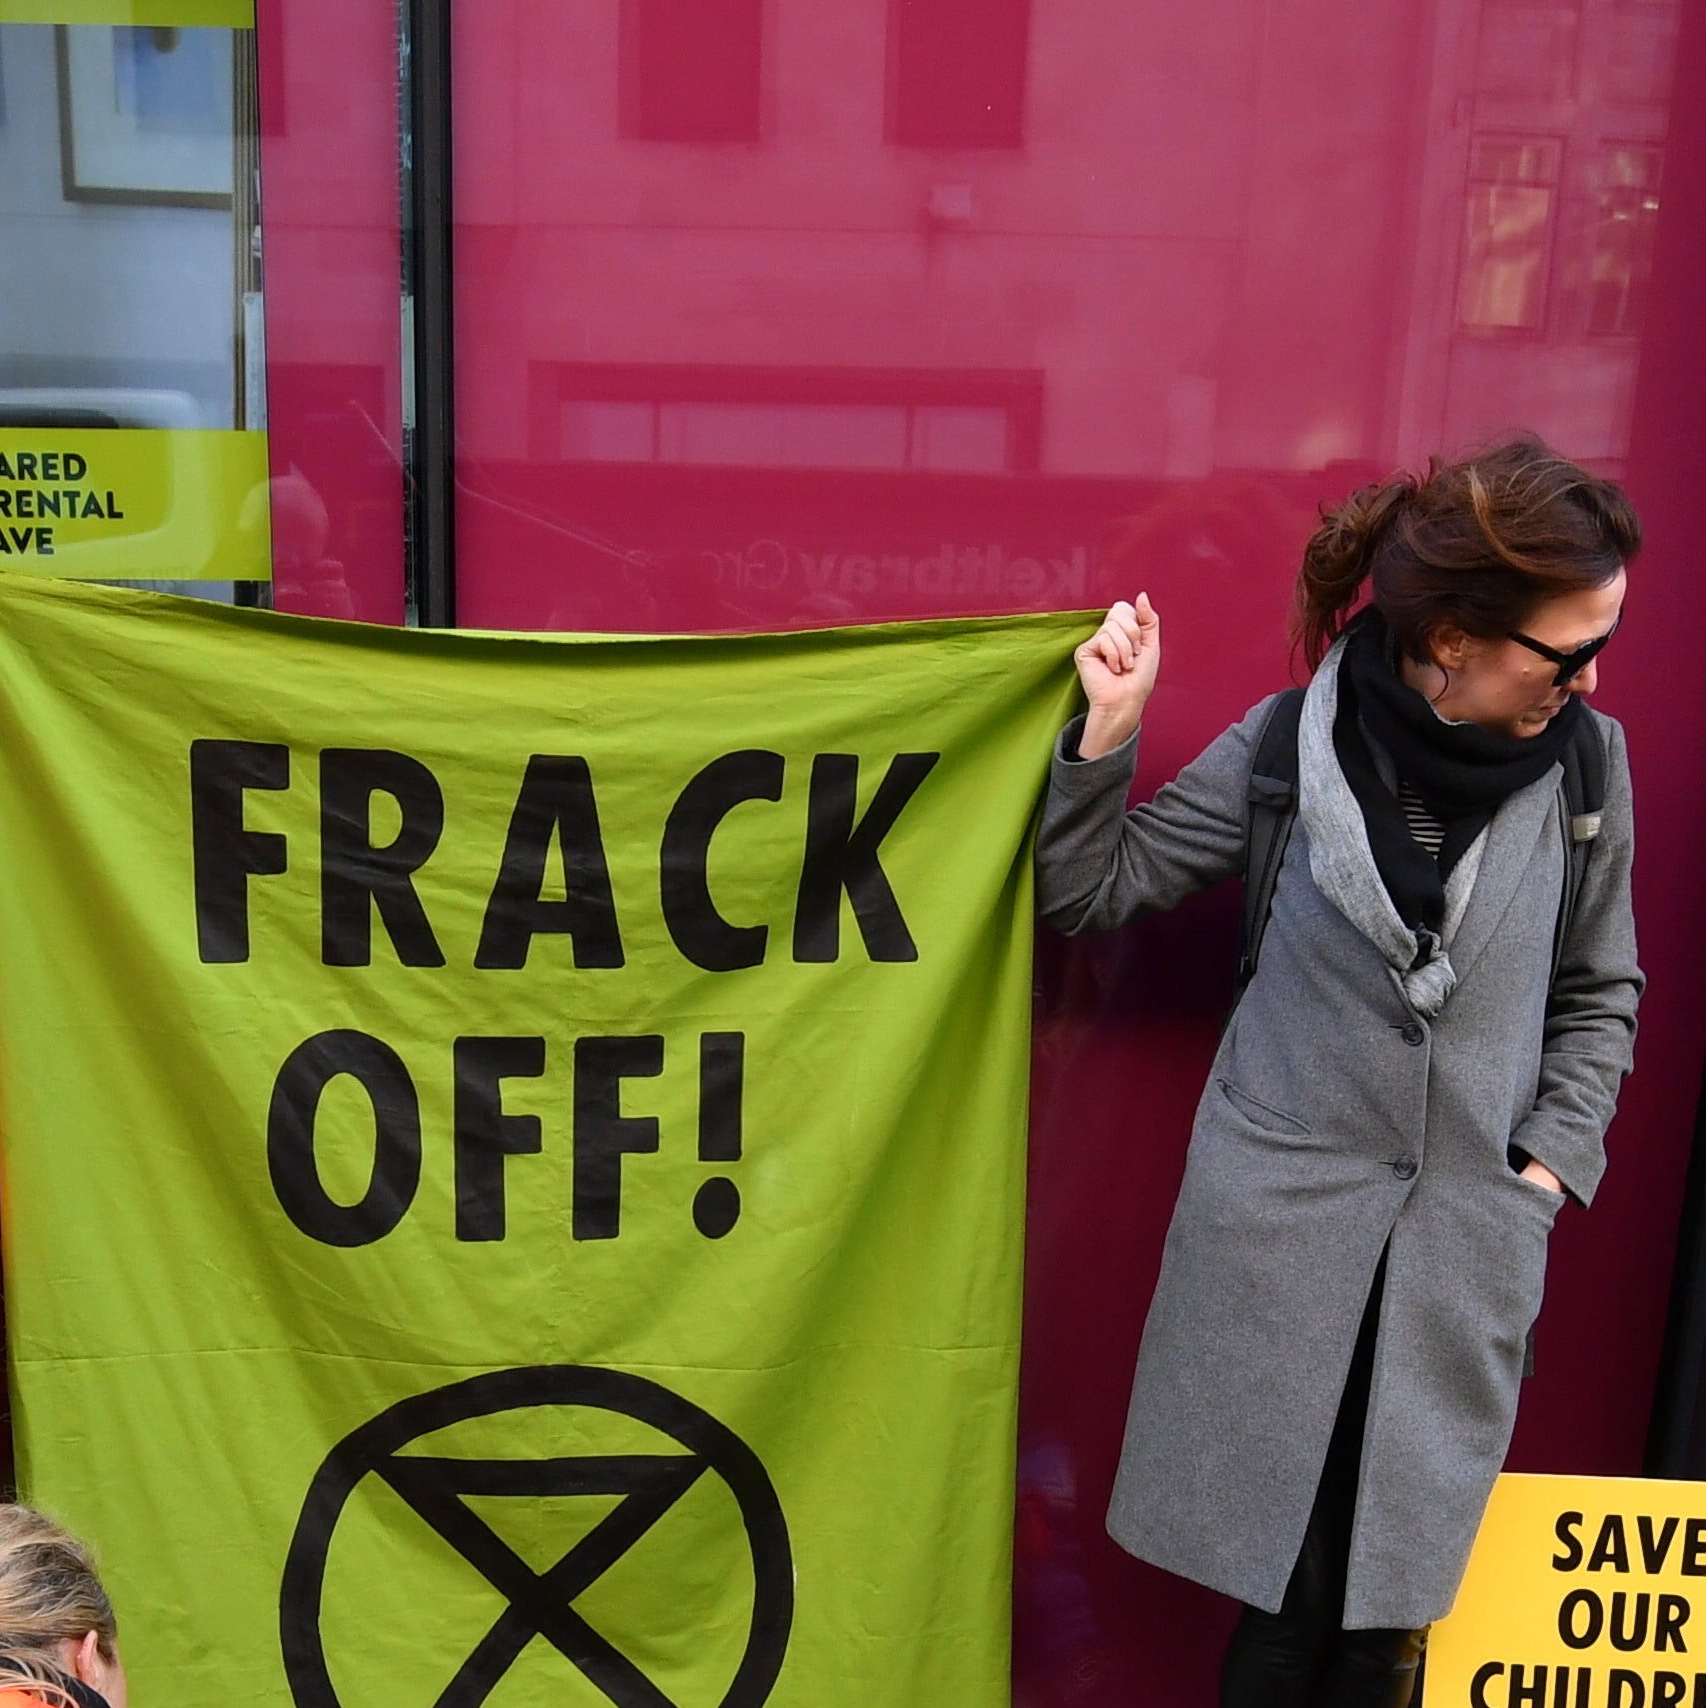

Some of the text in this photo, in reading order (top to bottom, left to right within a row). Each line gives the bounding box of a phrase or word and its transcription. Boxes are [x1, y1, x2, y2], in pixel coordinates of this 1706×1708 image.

[190, 737, 942, 973] FRACK
[267, 1027, 747, 1248] OFF!
[1557, 1588, 1690, 1654] OUR
